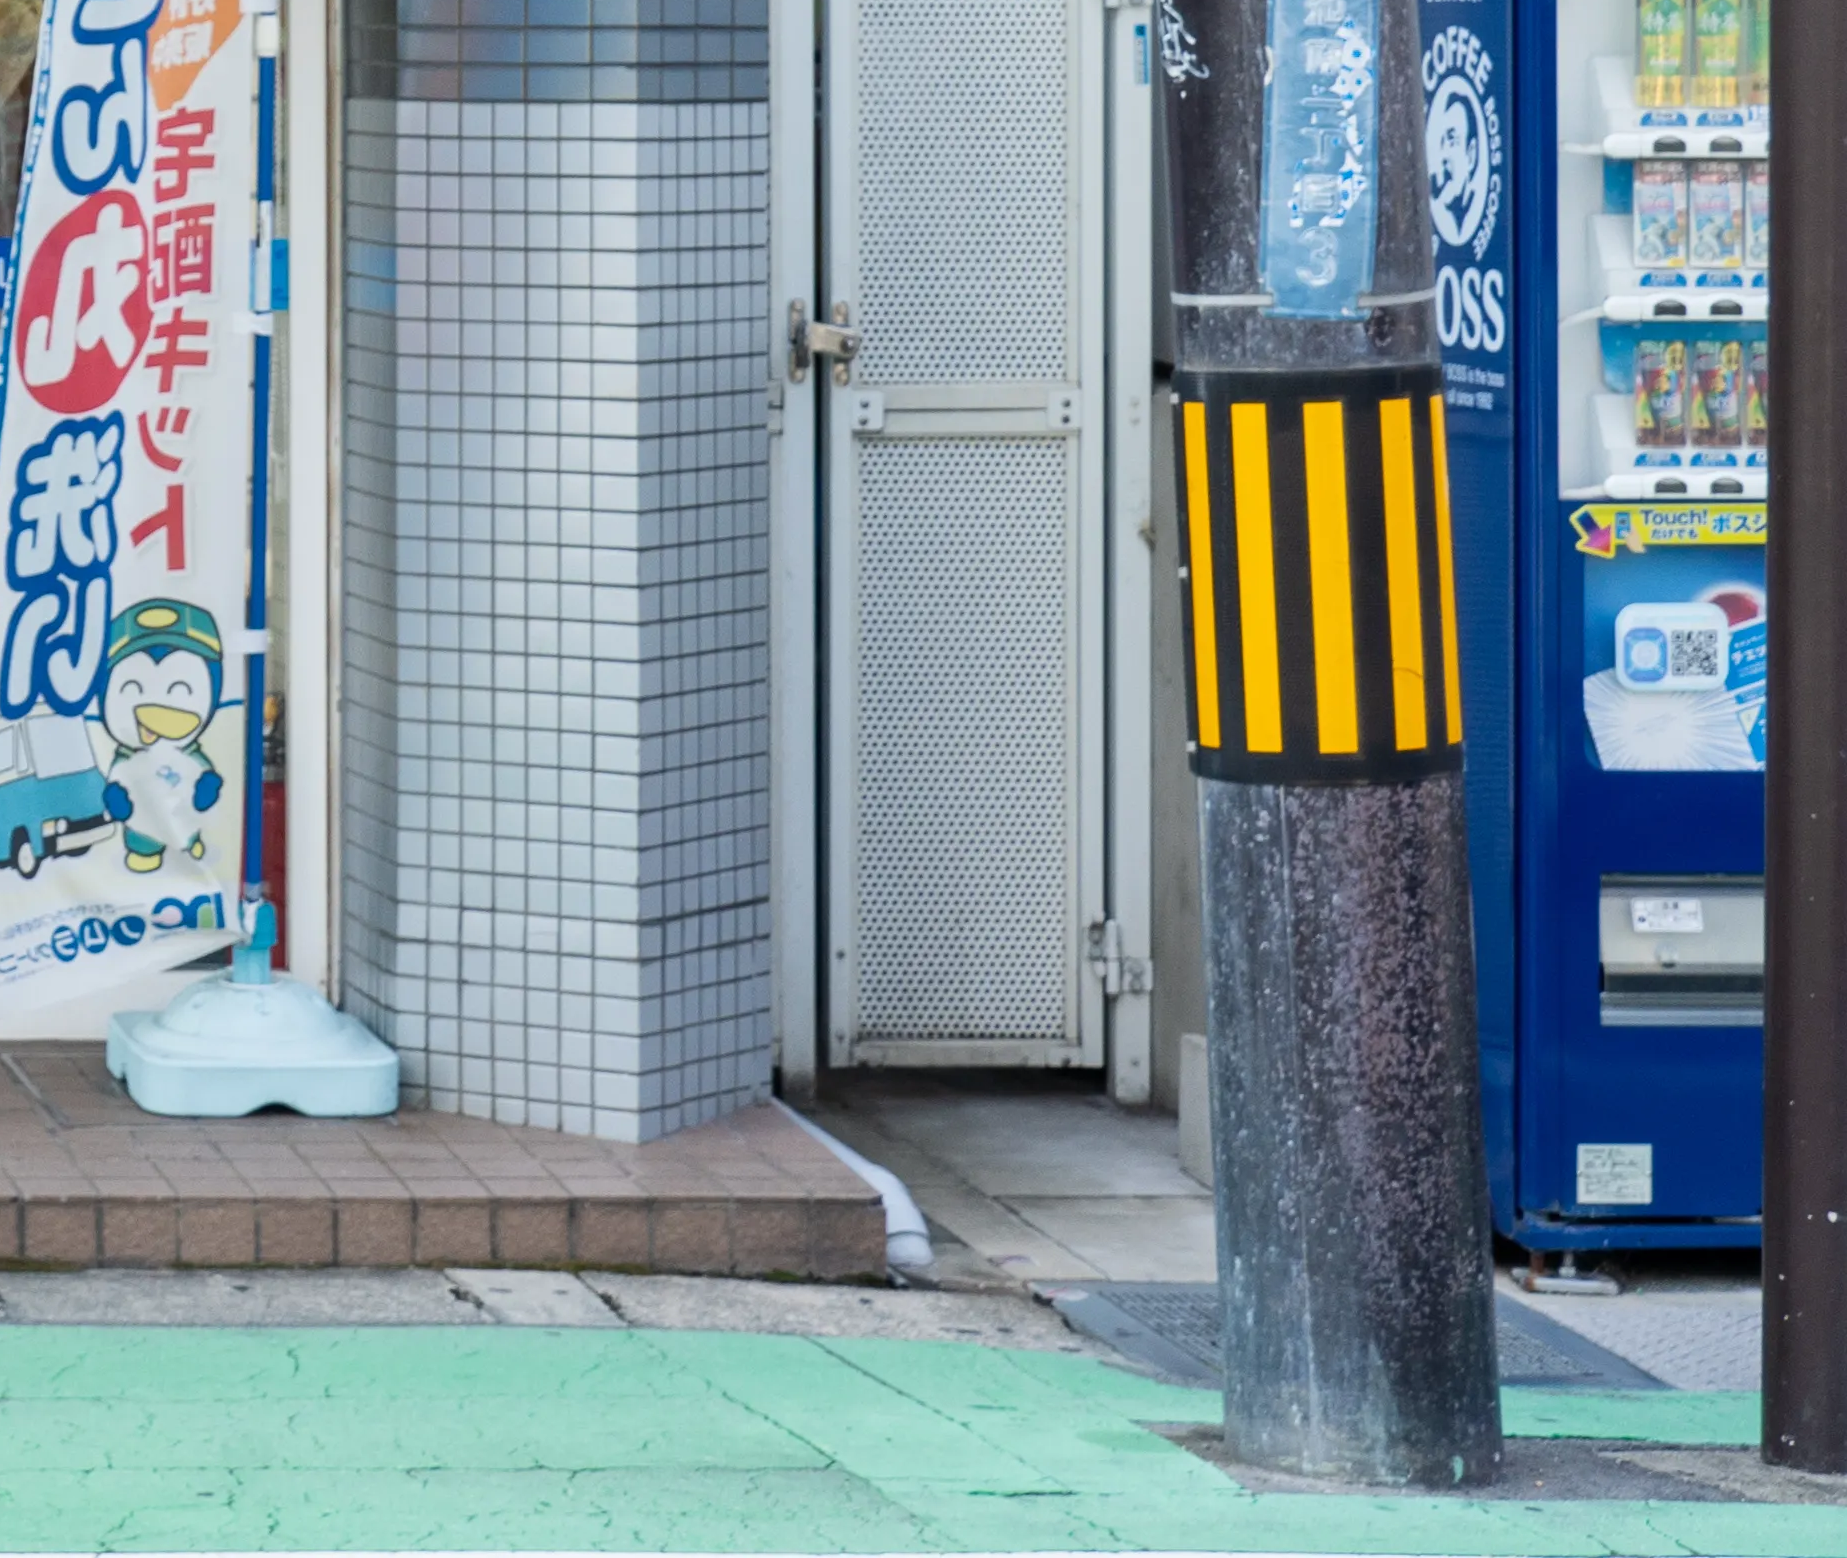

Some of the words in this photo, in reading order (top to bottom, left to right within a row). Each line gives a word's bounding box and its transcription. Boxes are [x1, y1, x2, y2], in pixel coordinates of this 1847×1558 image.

[1422, 25, 1494, 84] COFFEE
[1435, 265, 1506, 353] OSS
[1640, 509, 1708, 527] Touch!
